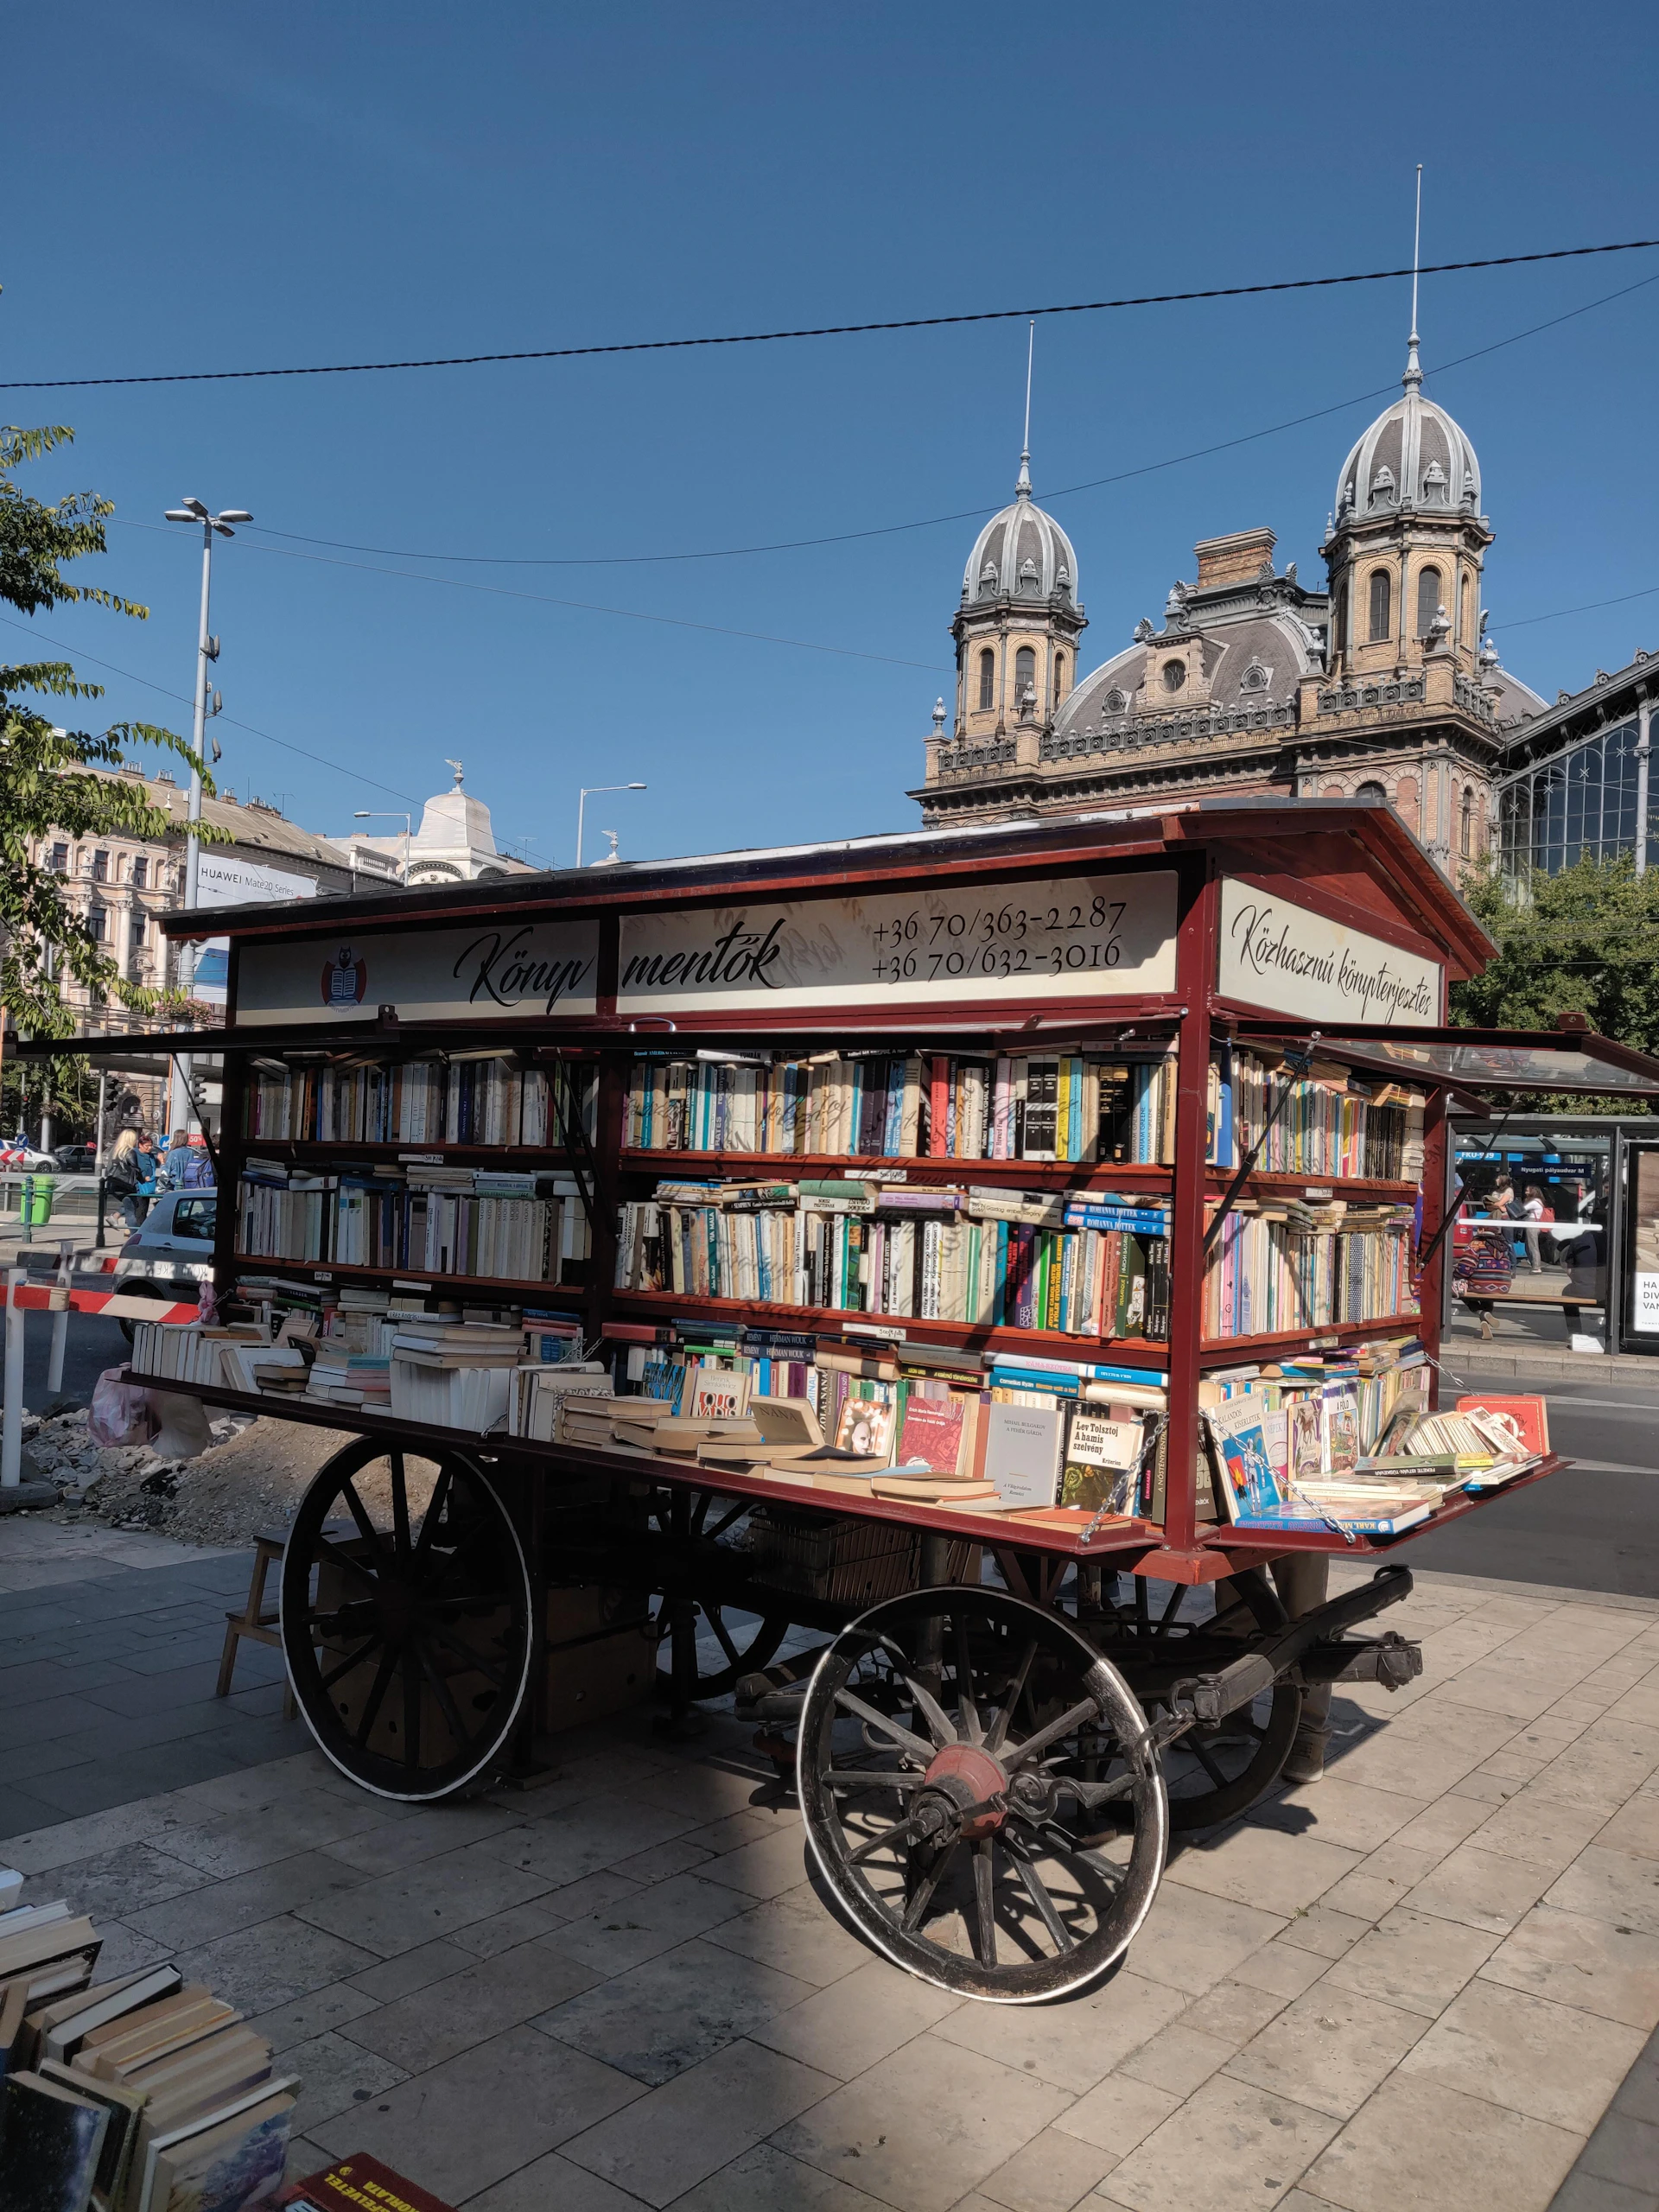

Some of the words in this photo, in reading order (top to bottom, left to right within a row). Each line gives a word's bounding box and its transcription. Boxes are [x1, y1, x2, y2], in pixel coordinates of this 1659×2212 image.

[201, 868, 241, 884] HUAWEI
[276, 884, 294, 896] Series
[874, 908, 918, 949] +36
[929, 895, 1127, 945] 70/363-2287
[1231, 904, 1335, 986] Közhasznú
[873, 942, 917, 984] +36
[927, 934, 1121, 981] 70/632-3016
[454, 925, 597, 1015] Könyv
[622, 918, 785, 988] mentők
[982, 1119, 988, 1128] HA
[1090, 1205, 1115, 1215] ROHANVA
[1087, 1218, 1113, 1228] ROHANVA
[770, 1334, 791, 1343] HERMAN
[792, 1336, 807, 1344] WOUK
[766, 1347, 789, 1357] HERMAN
[789, 1350, 804, 1358] WOUK
[760, 1407, 798, 1422] NANA
[1076, 1421, 1090, 1431] Lev
[1091, 1423, 1118, 1437] Tolsztoj
[1082, 1434, 1103, 1443] hamis
[1073, 1443, 1103, 1455] szelvény
[1102, 1458, 1122, 1466] Kriterion
[324, 2174, 391, 2212] FELVÉTEL
